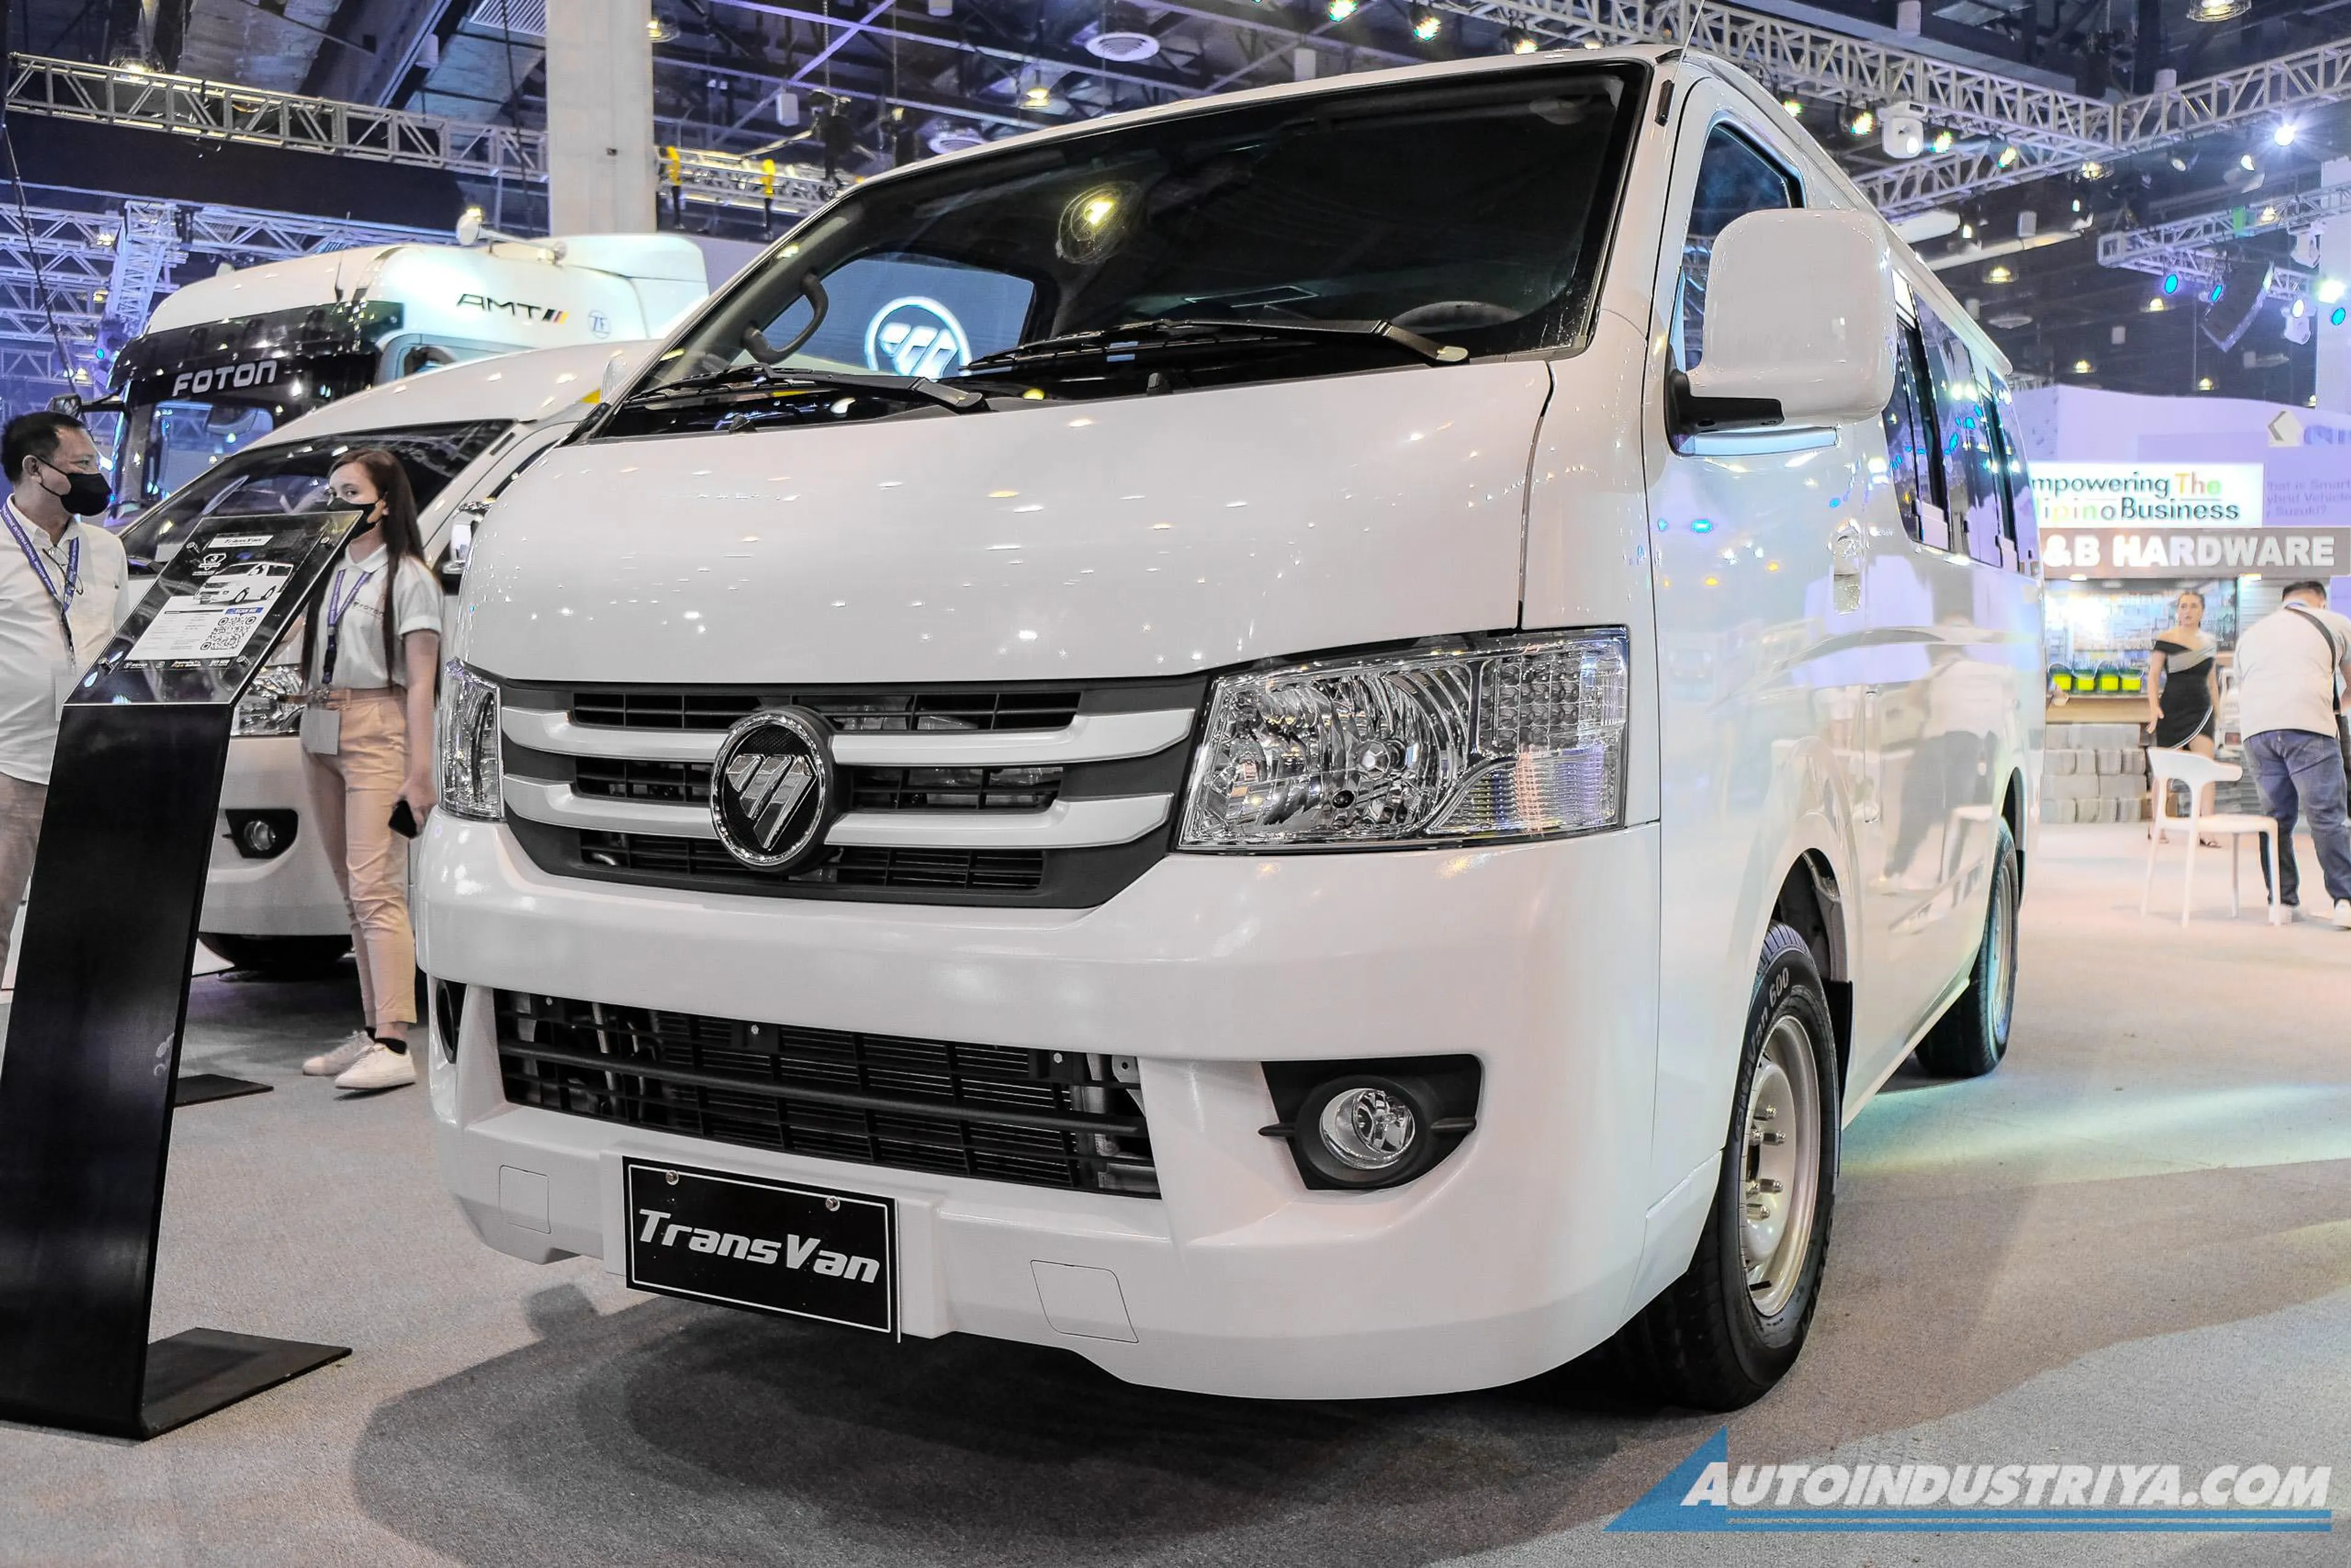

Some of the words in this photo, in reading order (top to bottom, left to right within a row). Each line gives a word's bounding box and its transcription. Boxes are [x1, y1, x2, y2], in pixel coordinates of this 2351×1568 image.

[456, 293, 541, 319] AMT
[171, 359, 277, 397] FOTON
[2031, 471, 2169, 499] mpowering
[2175, 472, 2222, 495] The
[2268, 492, 2300, 506] ybrid
[2036, 498, 2117, 523] lipino
[2121, 497, 2240, 520] Business
[2042, 534, 2100, 567] &B
[2112, 534, 2334, 567] HARDWARE
[1769, 967, 1790, 1008] 600
[639, 1209, 880, 1283] TransVan
